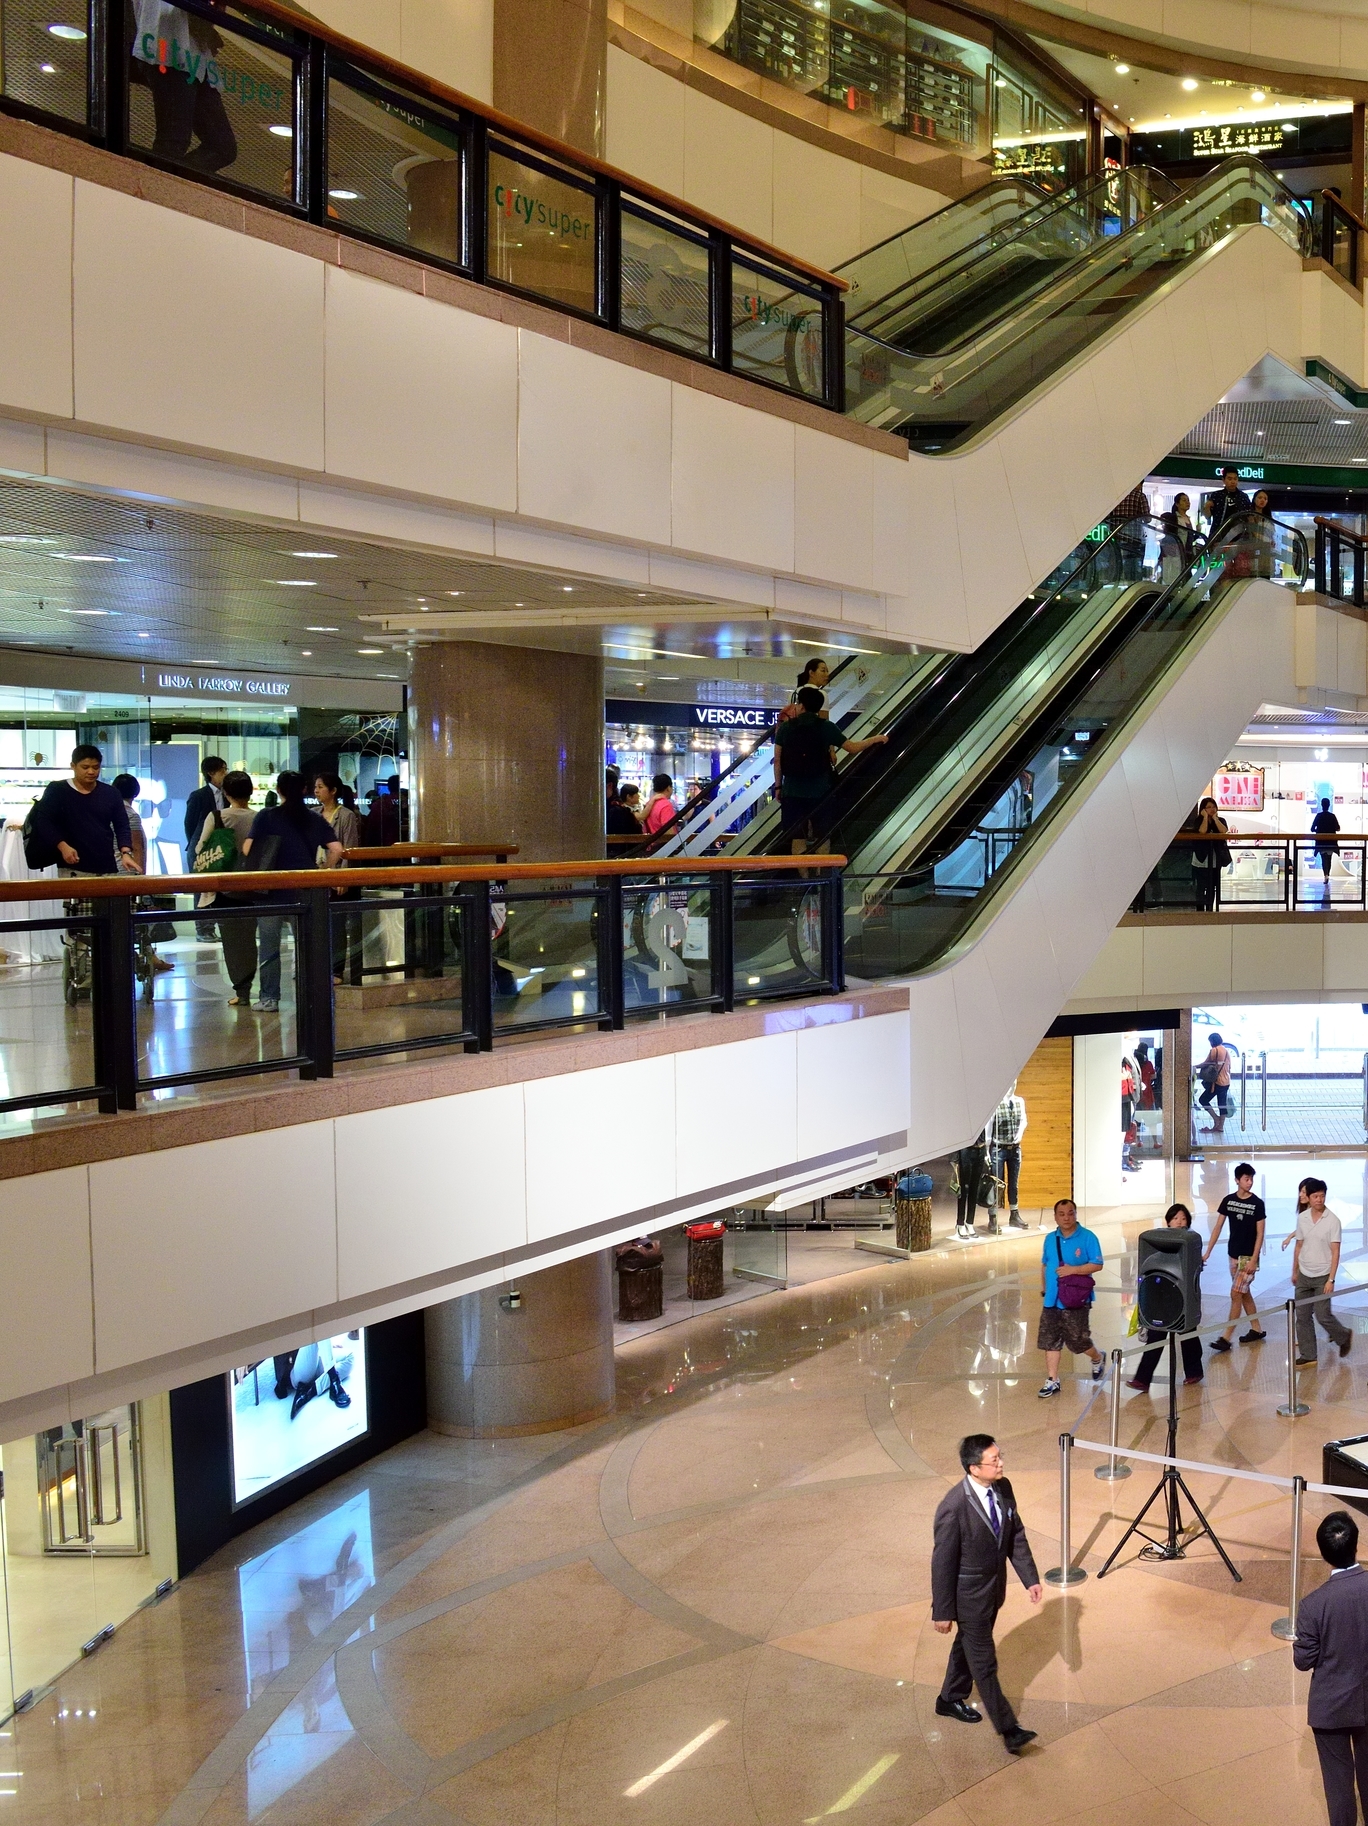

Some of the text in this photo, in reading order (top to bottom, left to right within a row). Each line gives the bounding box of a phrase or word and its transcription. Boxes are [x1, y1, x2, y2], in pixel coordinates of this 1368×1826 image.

[1215, 466, 1264, 479] coedDeli
[158, 674, 194, 688] LINDA
[246, 680, 290, 695] GALLERY
[696, 708, 765, 725] VERSACE
